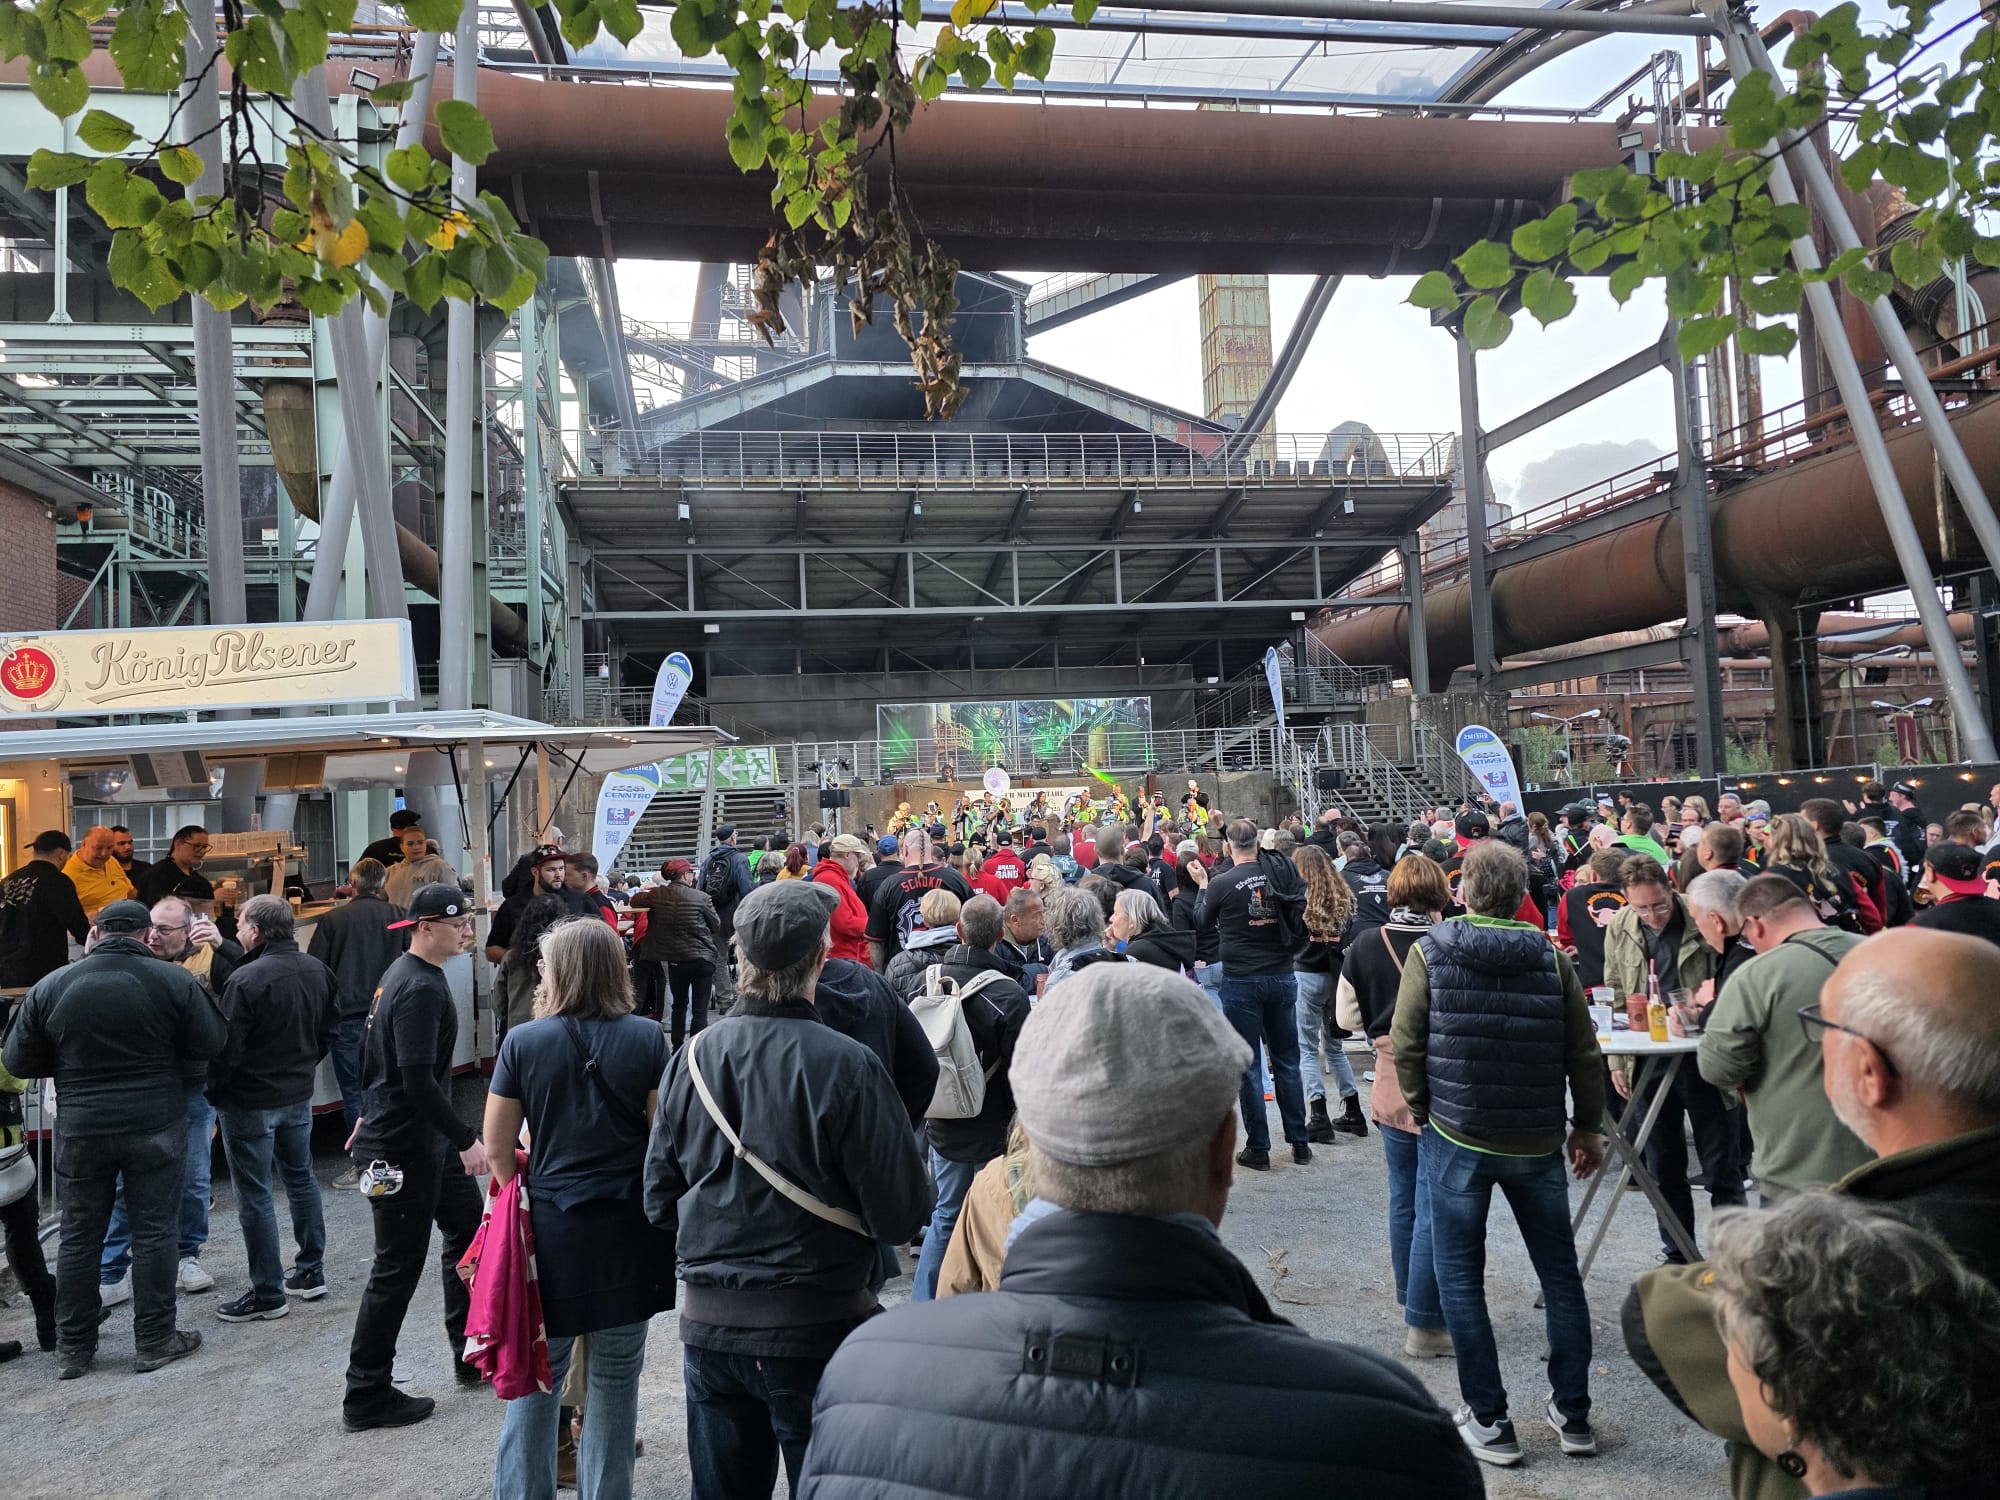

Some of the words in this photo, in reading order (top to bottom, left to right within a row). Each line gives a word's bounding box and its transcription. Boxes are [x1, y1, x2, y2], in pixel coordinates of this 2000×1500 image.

[84, 639, 208, 691] König
[207, 630, 356, 677] Pilsener
[995, 867, 1019, 879] BAND
[900, 878, 943, 893] SCHOKO
